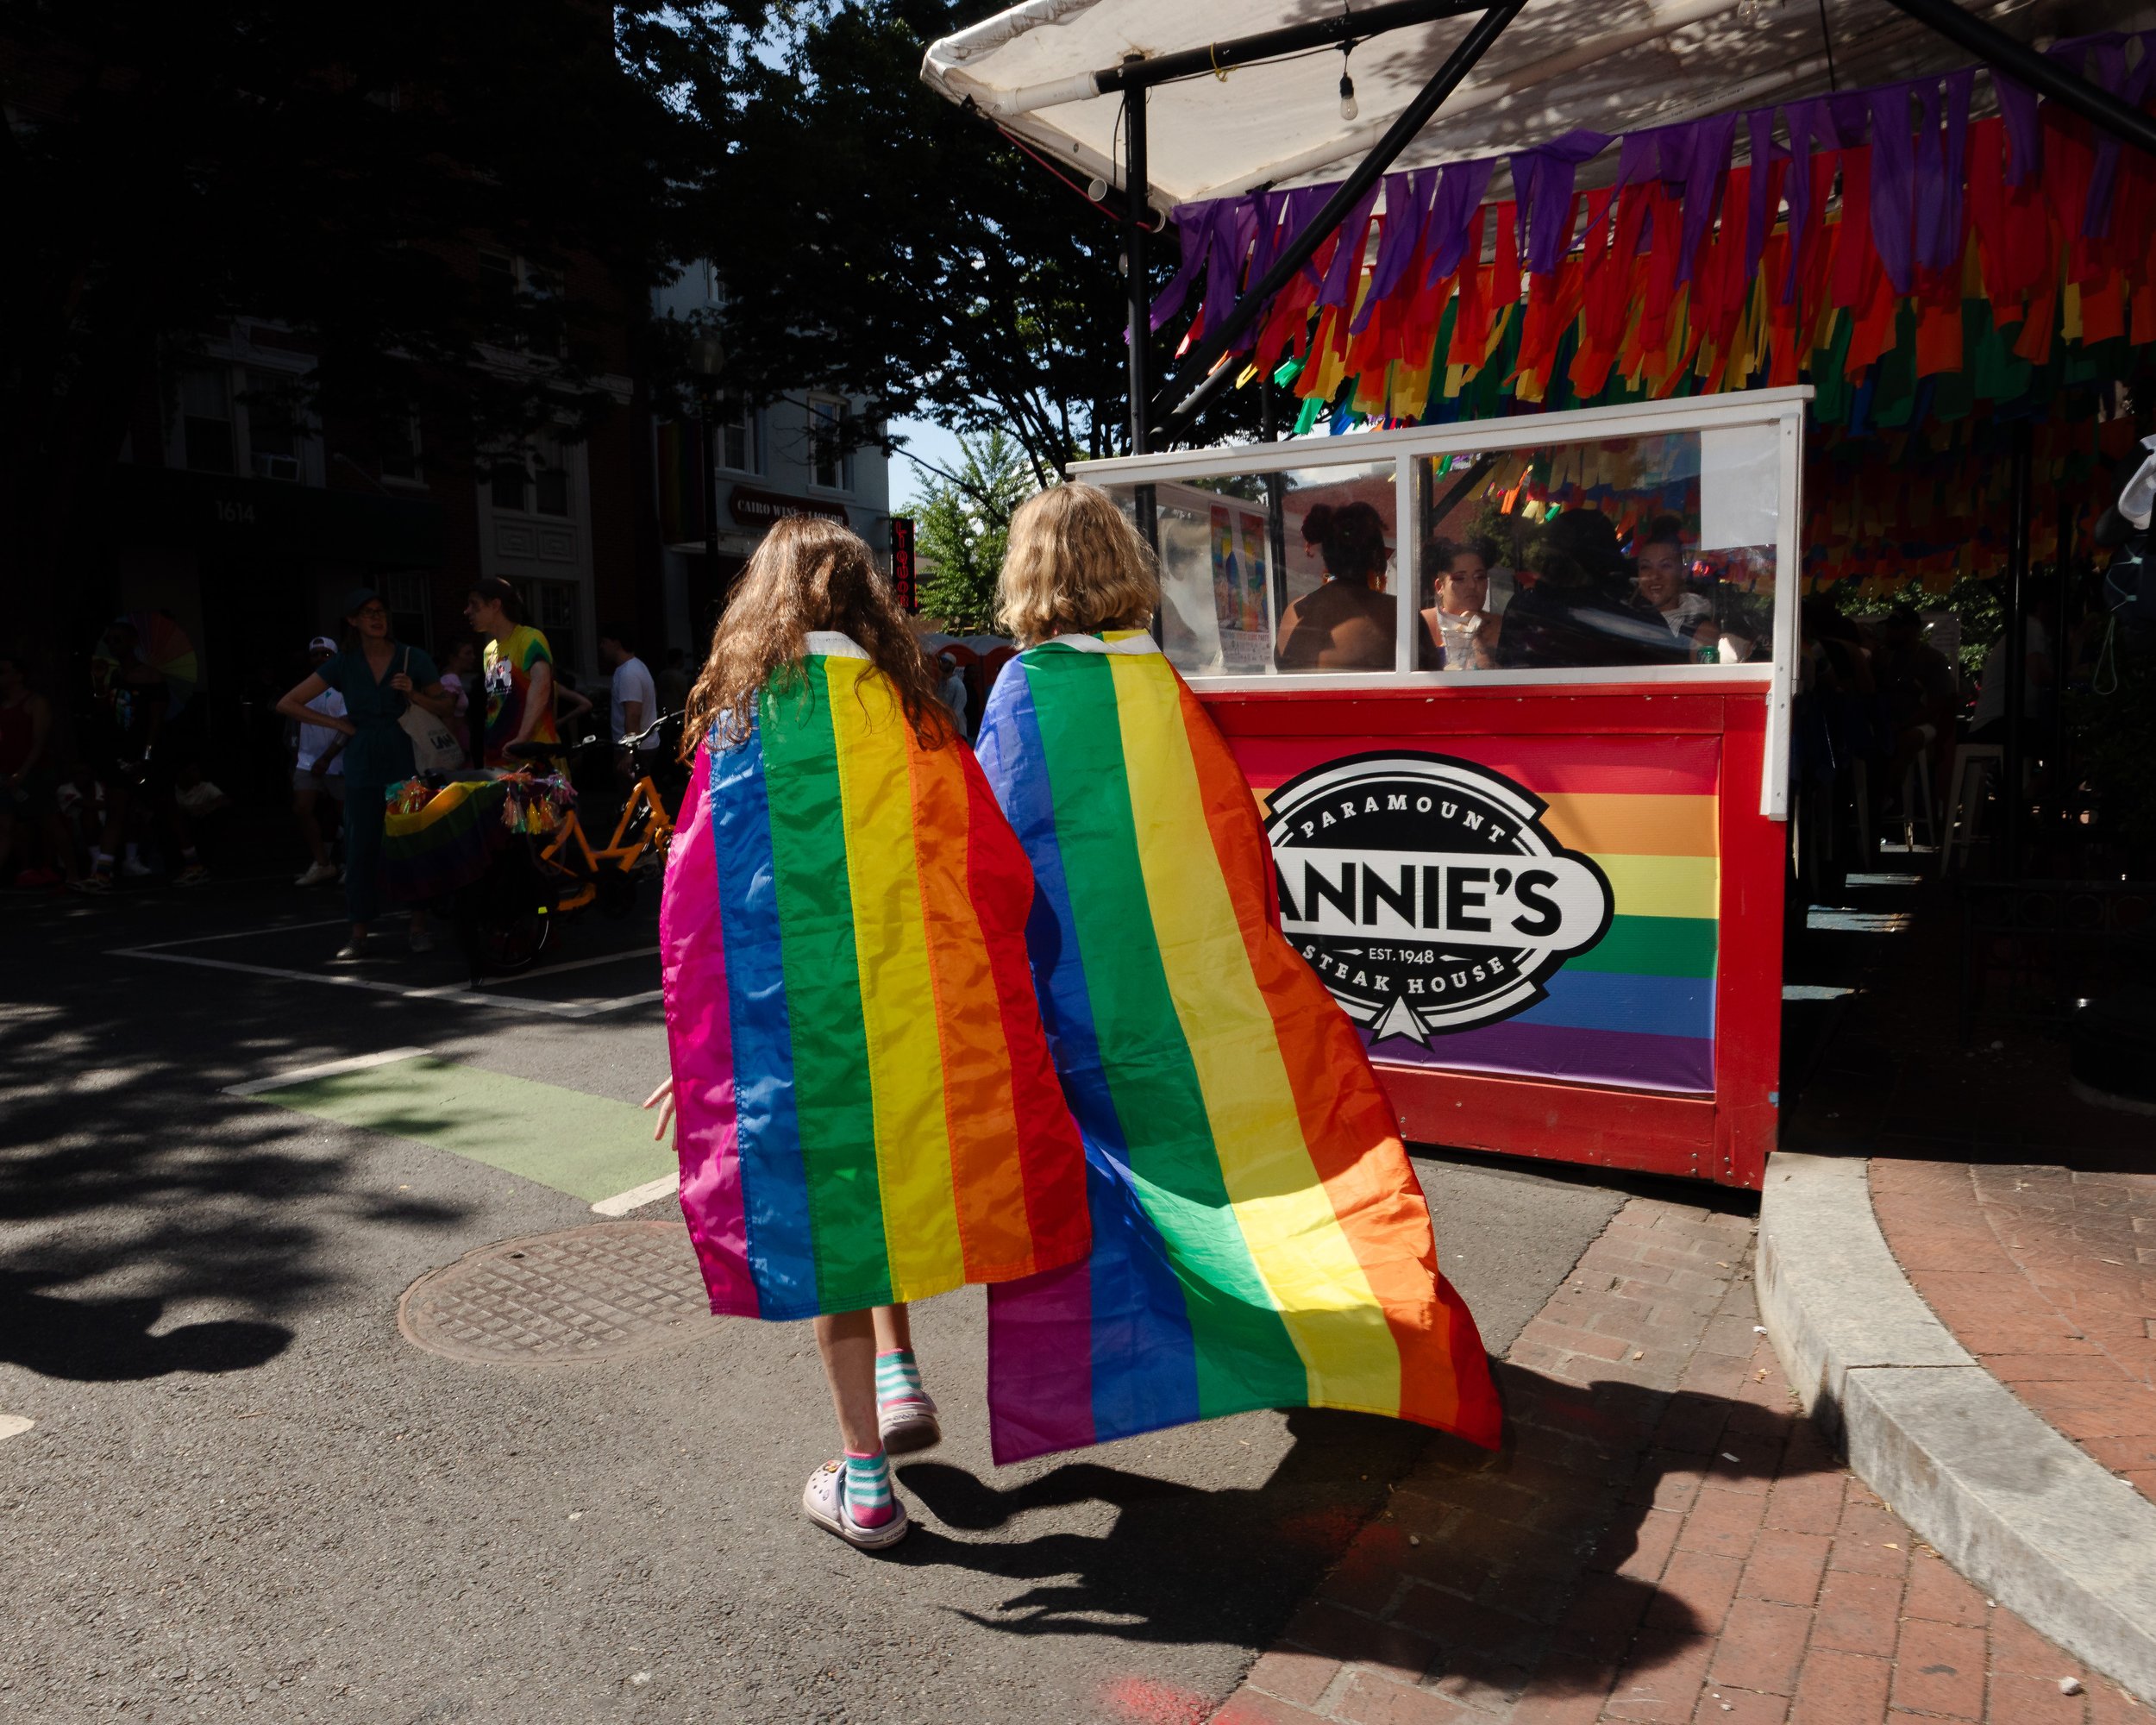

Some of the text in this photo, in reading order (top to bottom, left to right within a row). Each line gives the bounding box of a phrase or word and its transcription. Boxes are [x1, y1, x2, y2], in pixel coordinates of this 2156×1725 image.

[214, 499, 256, 524] 1614
[737, 499, 770, 515] CAIRO
[895, 521, 909, 608] LIQUOR
[1300, 794, 1507, 844] PARAMOUNT
[1301, 944, 1505, 994] STEAK HOUSE
[1369, 948, 1435, 965] EST. 1948
